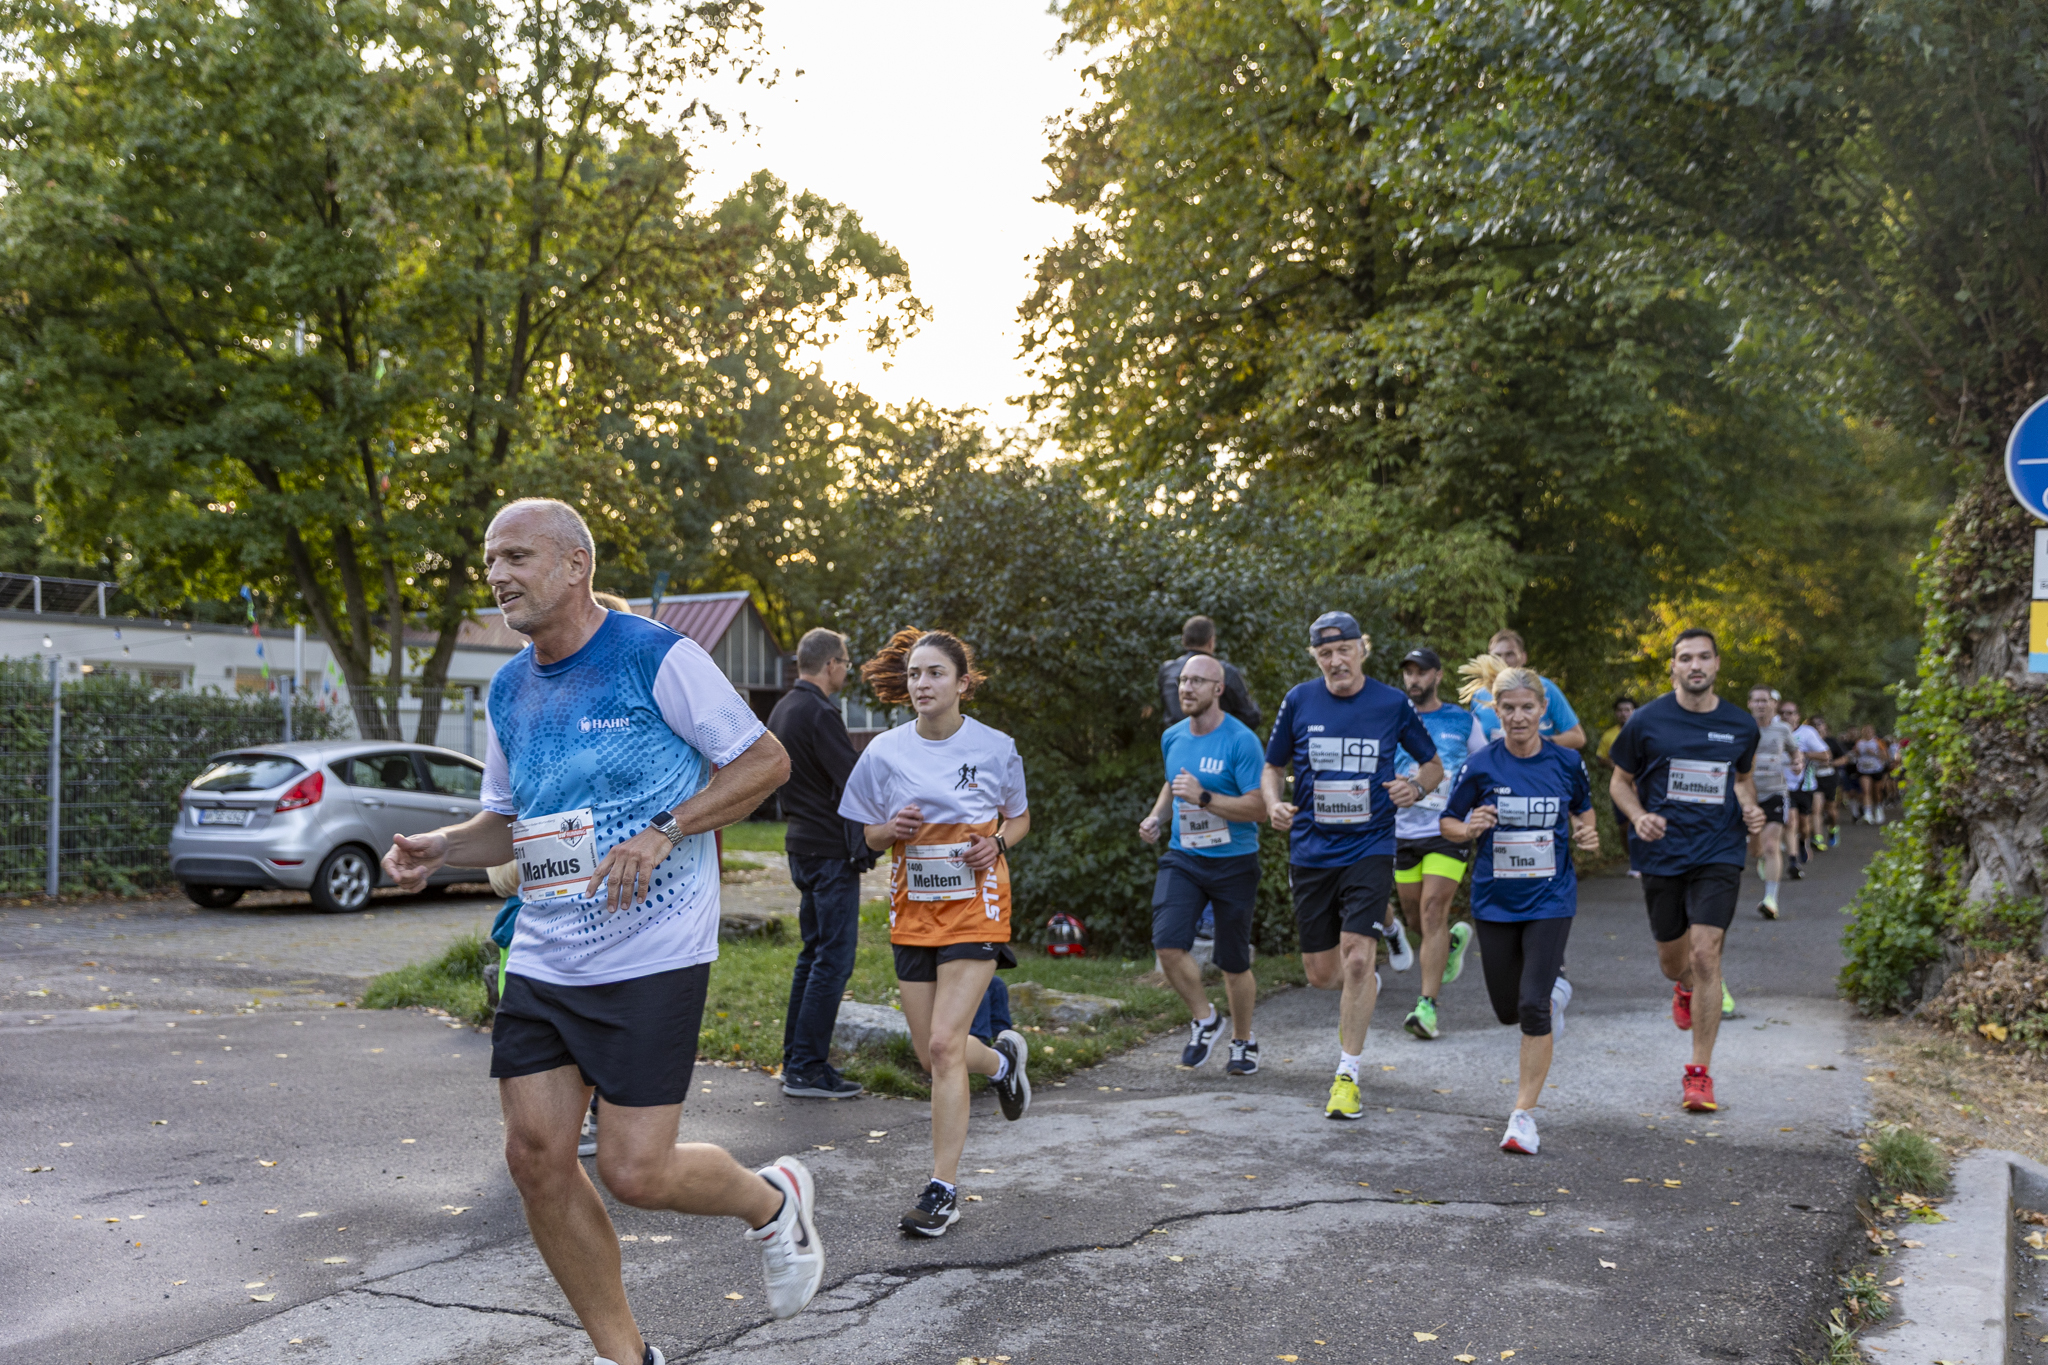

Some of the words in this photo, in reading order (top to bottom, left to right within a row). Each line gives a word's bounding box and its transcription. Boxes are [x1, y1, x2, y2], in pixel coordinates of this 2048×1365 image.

[592, 717, 629, 729] HAHN
[1672, 781, 1719, 794] Matthias
[1316, 802, 1363, 813] Matthias
[1189, 820, 1209, 831] Ralf
[907, 862, 923, 872] 1400
[1509, 856, 1535, 867] Tina
[522, 858, 581, 882] Markus
[913, 874, 962, 888] Meltem
